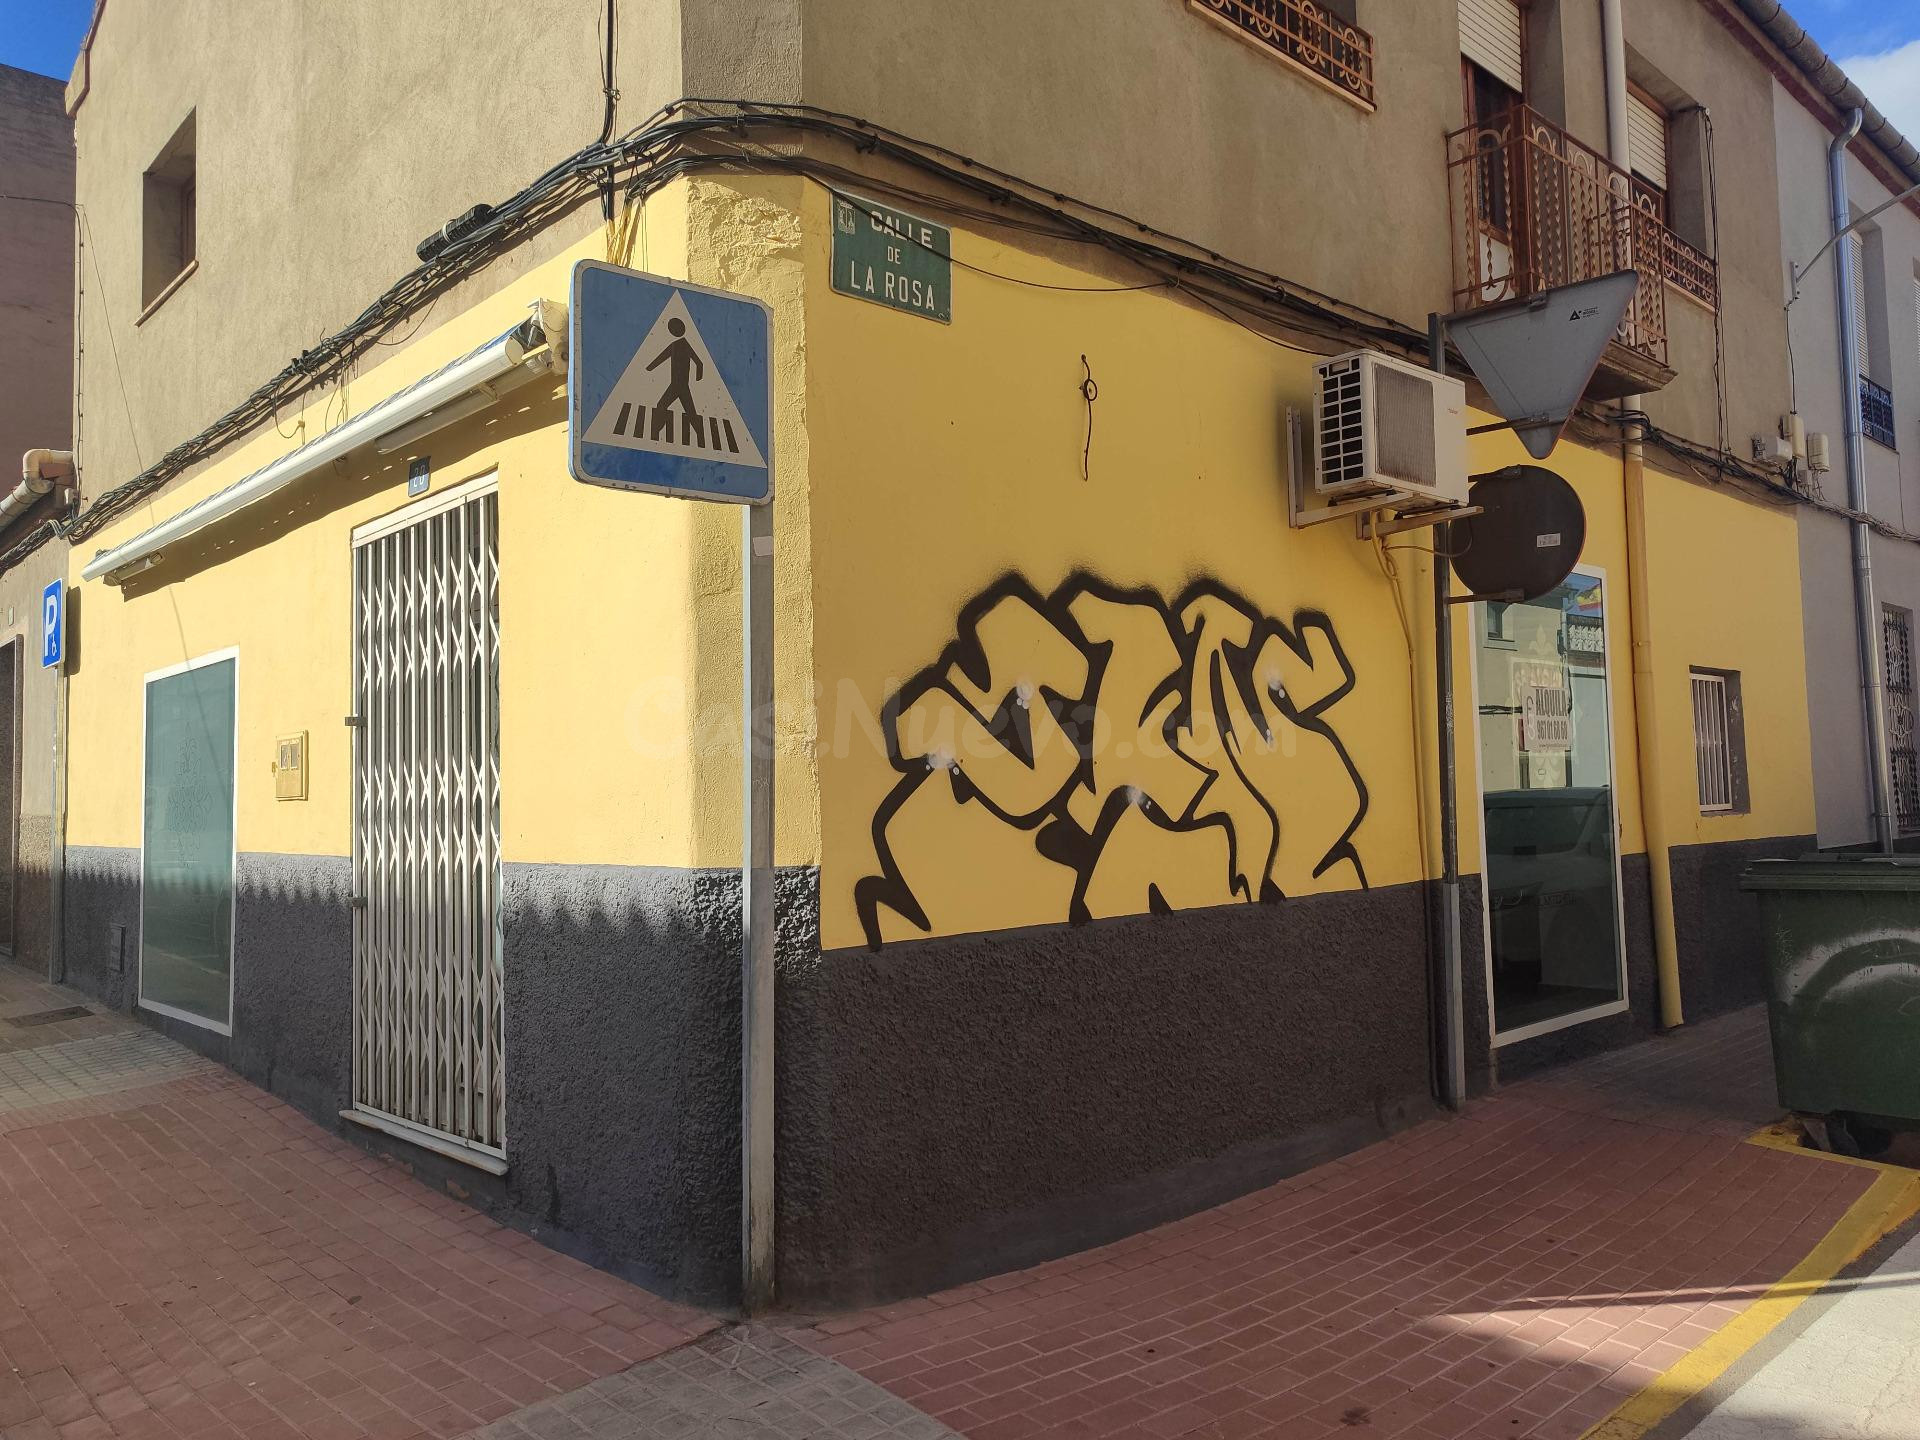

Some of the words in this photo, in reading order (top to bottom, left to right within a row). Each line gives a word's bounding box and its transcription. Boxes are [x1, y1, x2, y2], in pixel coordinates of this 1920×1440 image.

[871, 210, 933, 249] CALLE
[887, 245, 901, 265] DE
[851, 260, 875, 294] LA
[885, 271, 935, 311] ROSA
[44, 594, 58, 657] P
[1535, 688, 1568, 717] ALQUILA
